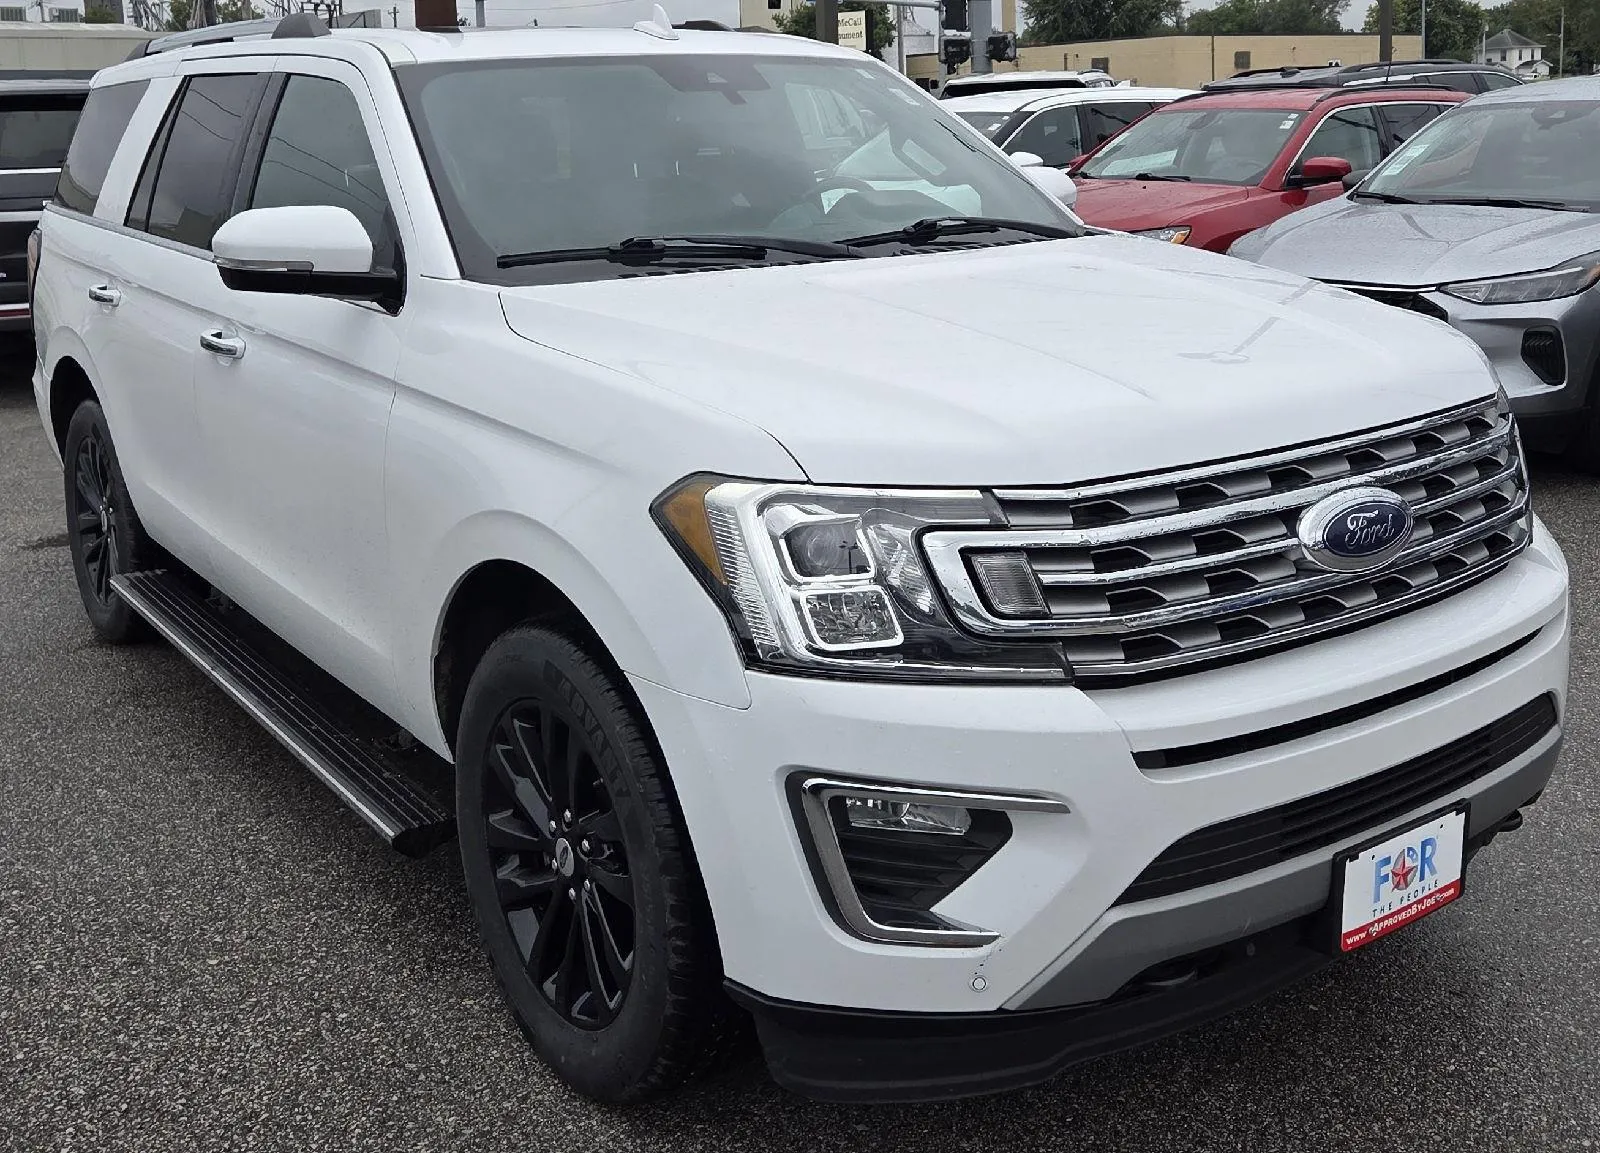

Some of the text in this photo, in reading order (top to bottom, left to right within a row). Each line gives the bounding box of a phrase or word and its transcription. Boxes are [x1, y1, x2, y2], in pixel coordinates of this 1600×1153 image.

[838, 17, 862, 27] McCall
[838, 31, 863, 40] nument
[1345, 509, 1395, 548] Ford
[1373, 837, 1438, 903] FOR
[1372, 879, 1438, 918] THE PEOPLE
